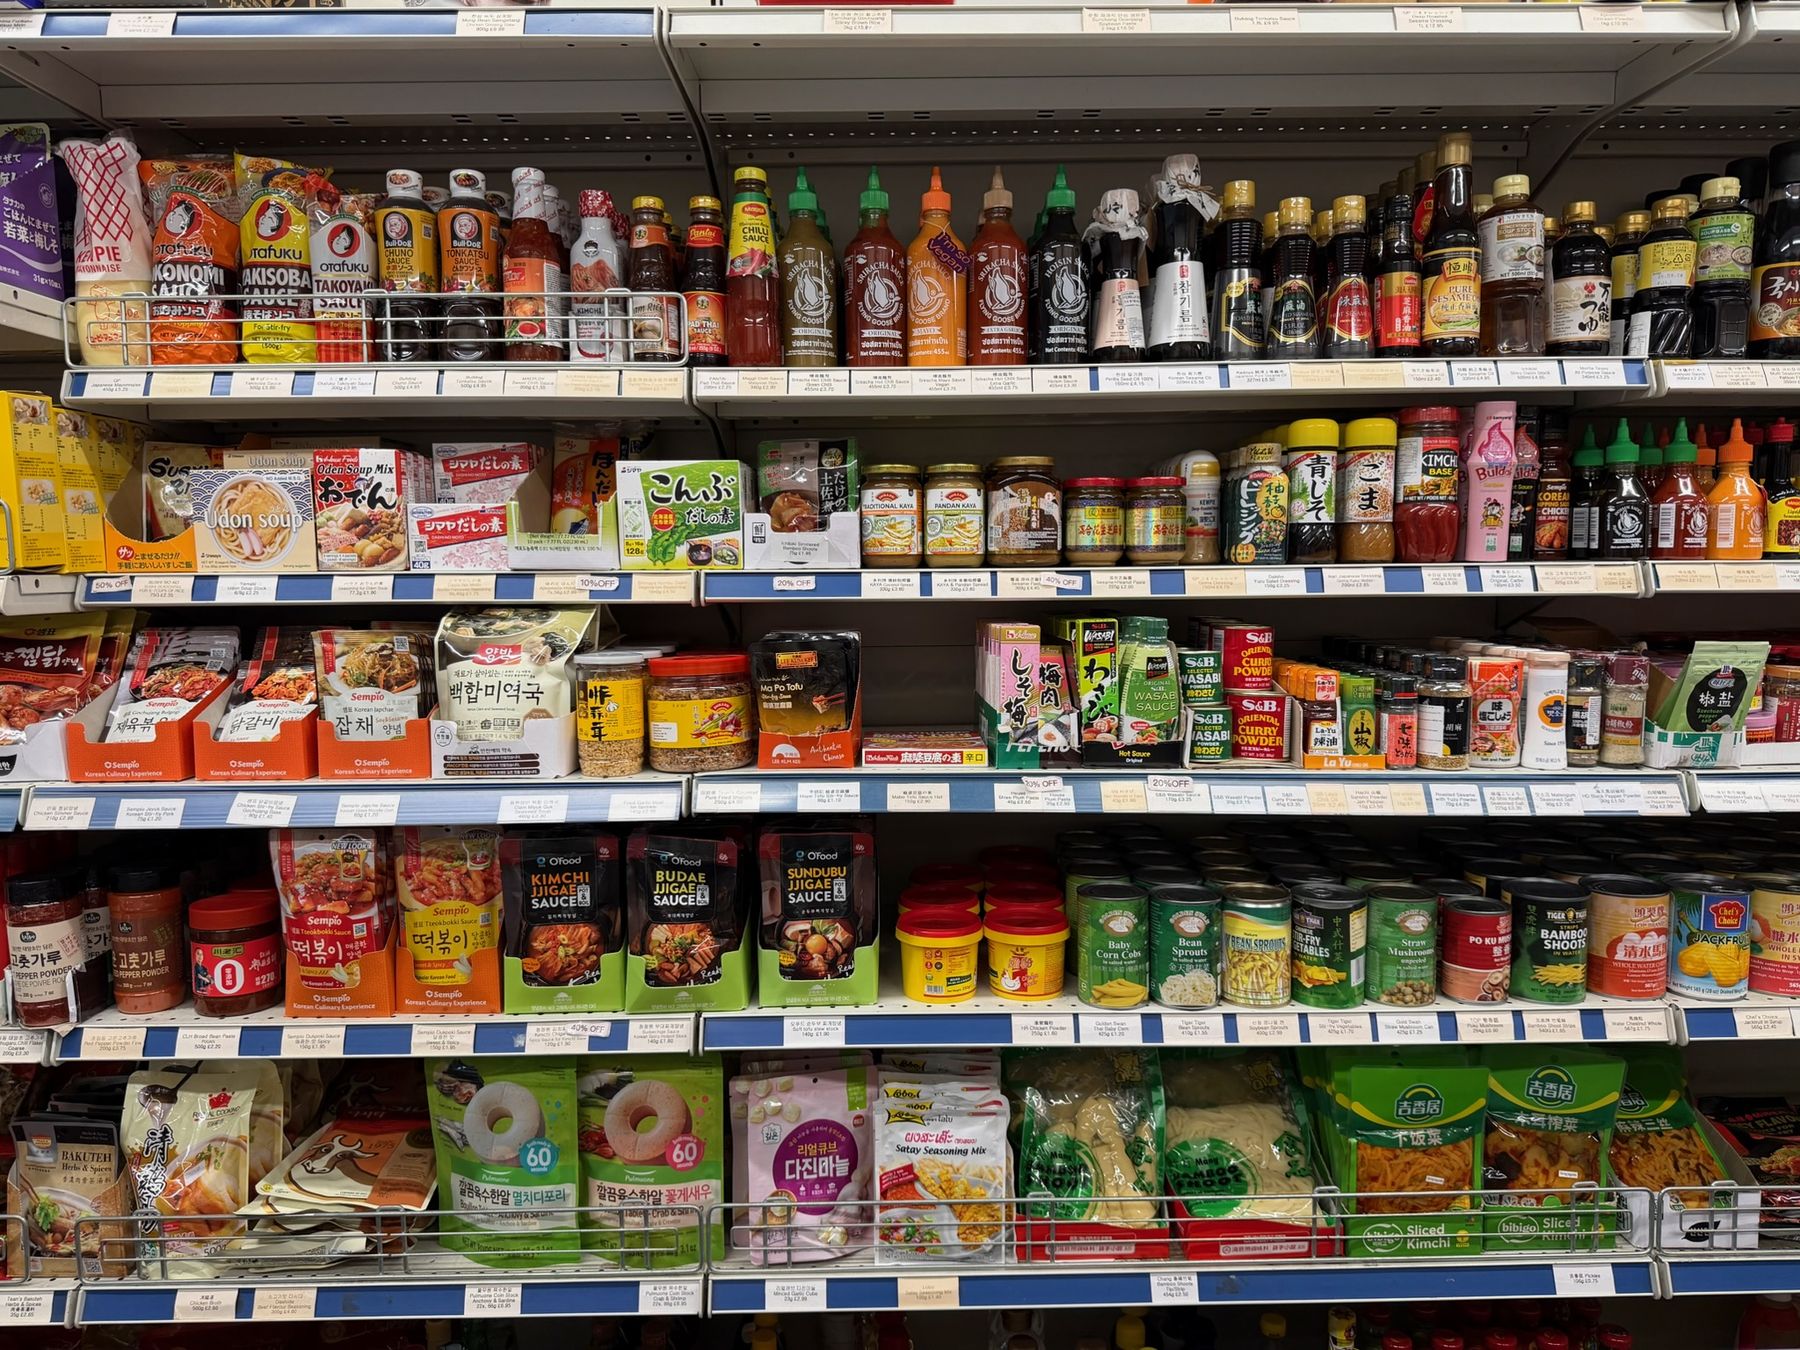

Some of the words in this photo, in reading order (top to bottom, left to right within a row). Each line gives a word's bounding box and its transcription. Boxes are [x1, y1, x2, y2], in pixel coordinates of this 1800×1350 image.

[3, 220, 59, 254] 若菜と梅しそ
[742, 227, 769, 237] CHILLI
[385, 249, 414, 258] CHUNO
[446, 249, 489, 260] TONKATSU
[929, 240, 963, 272] Vegan
[786, 260, 819, 282] SRIRACHA
[857, 261, 890, 284] SRIRACHA
[978, 259, 1011, 281] SRIRACHA
[1045, 257, 1073, 278] HOISIN
[1449, 285, 1473, 293] PURE
[1178, 280, 1193, 323] 참기름
[1433, 295, 1470, 303] SESAME
[1578, 300, 1600, 334] つゆ
[248, 456, 276, 467] Udon
[279, 457, 305, 468] soup
[449, 456, 523, 471] シマヤだしの素
[317, 464, 343, 474] Oden
[346, 465, 372, 476] Soup
[374, 465, 394, 475] Mix
[1428, 468, 1453, 476] BASE
[650, 473, 735, 504] こんぶ
[1305, 454, 1330, 522] 青じそ
[1359, 460, 1385, 512] ごま
[318, 478, 397, 510] おでん
[205, 509, 252, 529] Udon
[259, 511, 304, 533] soup
[685, 507, 733, 525] だしの素
[424, 518, 503, 534] シマヤだしの素
[95, 580, 113, 590] 50%
[114, 579, 129, 589] OFF
[580, 579, 616, 588] 10%OFF
[777, 579, 794, 588] 20%
[796, 579, 812, 588] OFF
[1045, 577, 1061, 586] 40%
[1246, 632, 1272, 643] S&B
[15, 646, 66, 668] 찜닭
[1185, 657, 1215, 667] S&B
[760, 683, 773, 692] Ma
[774, 683, 785, 692] Po
[786, 682, 804, 691] Tofu
[1039, 662, 1062, 708] 梅肉
[350, 691, 384, 702] Sempio
[449, 680, 544, 705] 백합미역국
[1699, 691, 1734, 708] 椒盐
[374, 706, 394, 714] Japchae
[1136, 702, 1176, 711] SAUCE
[1241, 700, 1278, 711] S&B
[1195, 714, 1224, 724] S&B
[1238, 714, 1280, 727] ORIENTAL
[1479, 711, 1512, 722] 塩こしょう
[230, 714, 281, 734] 닭갈비
[1238, 725, 1279, 736] CURRY
[1315, 727, 1336, 735] La-Yu
[1353, 722, 1372, 749] 山椒
[1233, 735, 1283, 746] POWDER
[1313, 737, 1338, 747] 辣油
[901, 751, 962, 764] 麻婆豆腐の素
[964, 752, 984, 763] 辛口
[1324, 757, 1337, 767] La
[1339, 757, 1352, 768] Yu
[112, 760, 140, 769] Sempio
[105, 770, 127, 778] Culinary
[128, 770, 163, 778] Experience
[253, 769, 287, 778] Experience
[355, 768, 377, 776] Culinary
[378, 767, 412, 776] Experience
[1043, 779, 1059, 788] OFF
[1152, 778, 1190, 788] 20%OFF
[549, 856, 582, 866] O'Food
[671, 856, 701, 867] O'Food
[807, 851, 838, 861] O'Food
[531, 872, 590, 884] KIMCHI
[656, 871, 706, 883] BUDAE
[787, 867, 847, 878] SUNDUBU
[531, 884, 577, 897] JJIGAE
[654, 883, 696, 895] JJIGAE
[787, 878, 832, 892] JJIGAE
[531, 897, 577, 909] SAUCE
[653, 895, 696, 907] SAUCE
[788, 891, 832, 904] SAUCE
[433, 906, 469, 917] Sempio
[1547, 910, 1565, 920] TIGER
[1719, 906, 1738, 917] Chef's
[307, 915, 341, 926] Sempio
[459, 918, 478, 926] Sauce
[1718, 916, 1738, 925] Choice
[332, 928, 352, 936] Sauce
[1541, 929, 1588, 940] BAMBOO
[412, 928, 469, 955] 떡볶이
[1108, 940, 1131, 951] Baby
[1178, 938, 1202, 947] Bean
[1253, 937, 1287, 951] SPROUTS
[1402, 939, 1427, 948] Straw
[1469, 936, 1481, 945] PO
[1482, 936, 1496, 945] KU
[1544, 938, 1586, 950] SHOOTS
[291, 939, 343, 963] 떡볶이
[1096, 950, 1119, 959] Corn
[1121, 949, 1141, 959] Cobs
[1172, 947, 1208, 958] Sprouts
[1388, 947, 1435, 957] Mushrooms
[11, 951, 62, 968] 고춧가루
[119, 951, 166, 968] 고춧가루
[120, 969, 142, 979] PEPPER
[142, 966, 169, 977] POWDER
[293, 1003, 314, 1011] Korean
[315, 1003, 339, 1012] Culinary
[340, 1003, 376, 1012] Experience
[571, 1024, 588, 1033] 40%
[590, 1025, 605, 1033] OFF
[1528, 1081, 1574, 1102] 吉香居
[1397, 1100, 1441, 1116] 吉香居
[672, 1145, 697, 1162] 60
[797, 1143, 838, 1154] 리얼큐브
[896, 1145, 921, 1156] Satay
[923, 1146, 969, 1157] Seasoning
[971, 1147, 987, 1156] Mix
[61, 1151, 112, 1163] BAKUTEH
[526, 1149, 551, 1165] 60
[62, 1164, 82, 1172] Herbs
[91, 1164, 112, 1174] Spices
[785, 1156, 850, 1180] 다진마늘
[512, 1188, 566, 1206] 멸치디포리
[1502, 1222, 1539, 1235] bibigo
[1542, 1216, 1581, 1230] Sliced
[1406, 1224, 1446, 1237] Sliced
[1407, 1236, 1451, 1250] Kimchi
